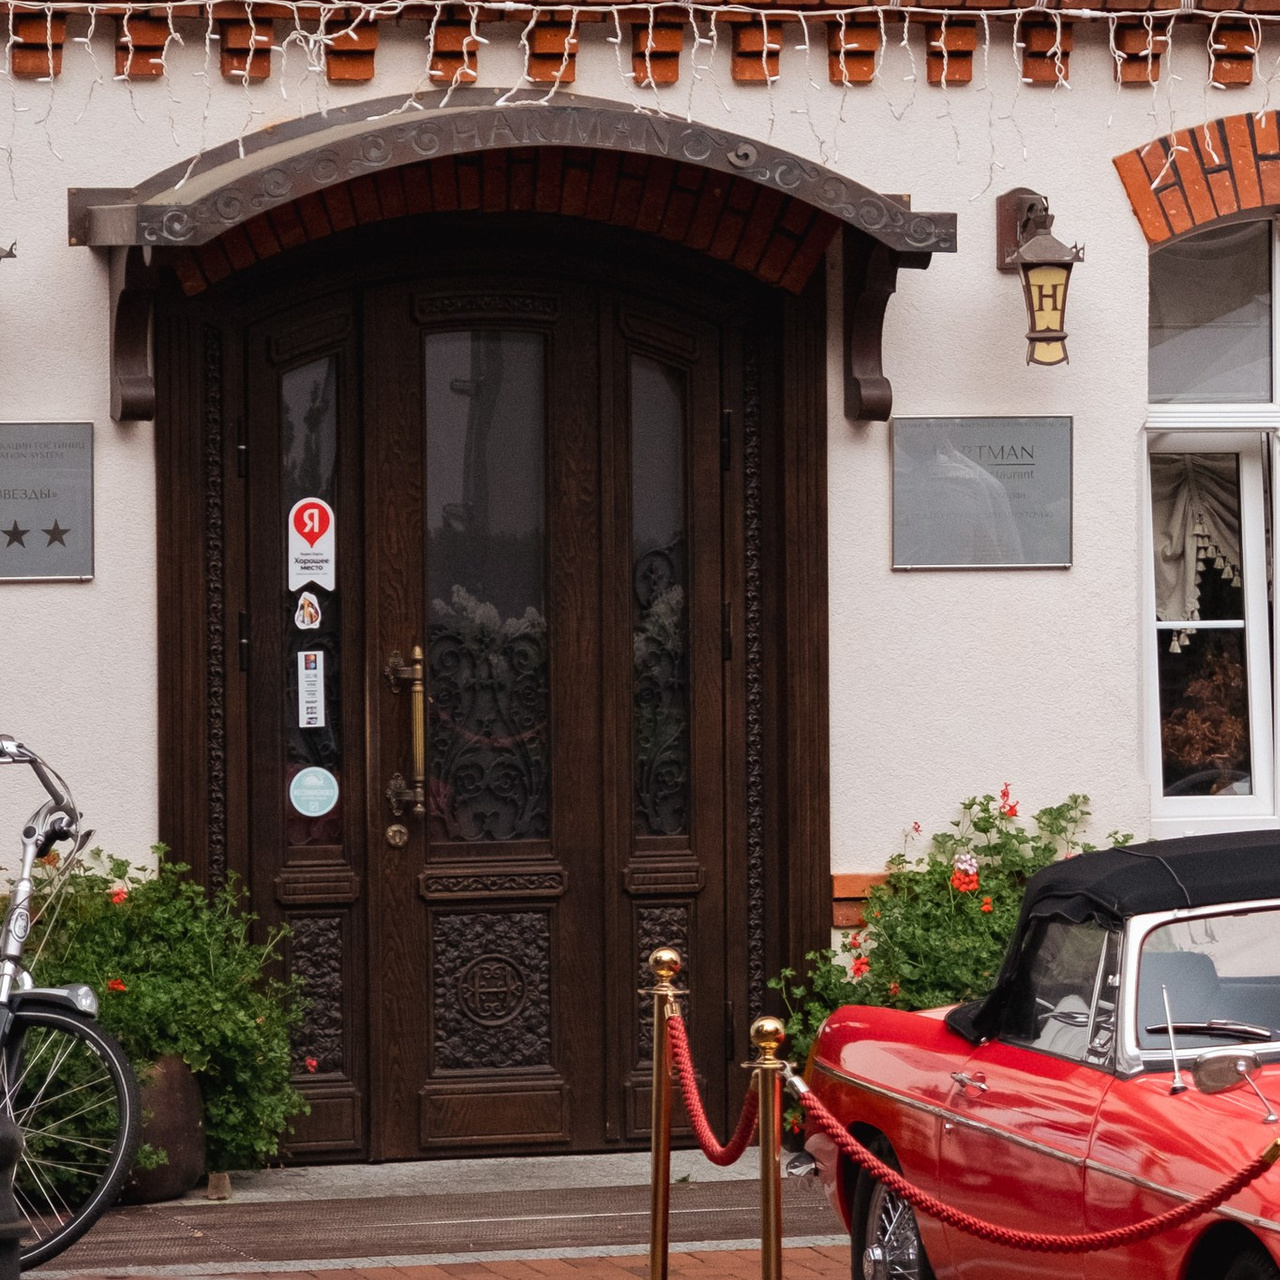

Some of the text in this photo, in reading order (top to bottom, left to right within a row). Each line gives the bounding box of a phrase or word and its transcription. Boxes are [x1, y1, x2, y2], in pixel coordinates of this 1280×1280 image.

[1031, 283, 1064, 312] H
[302, 508, 319, 533] Я
[294, 557, 330, 565] Хорошее
